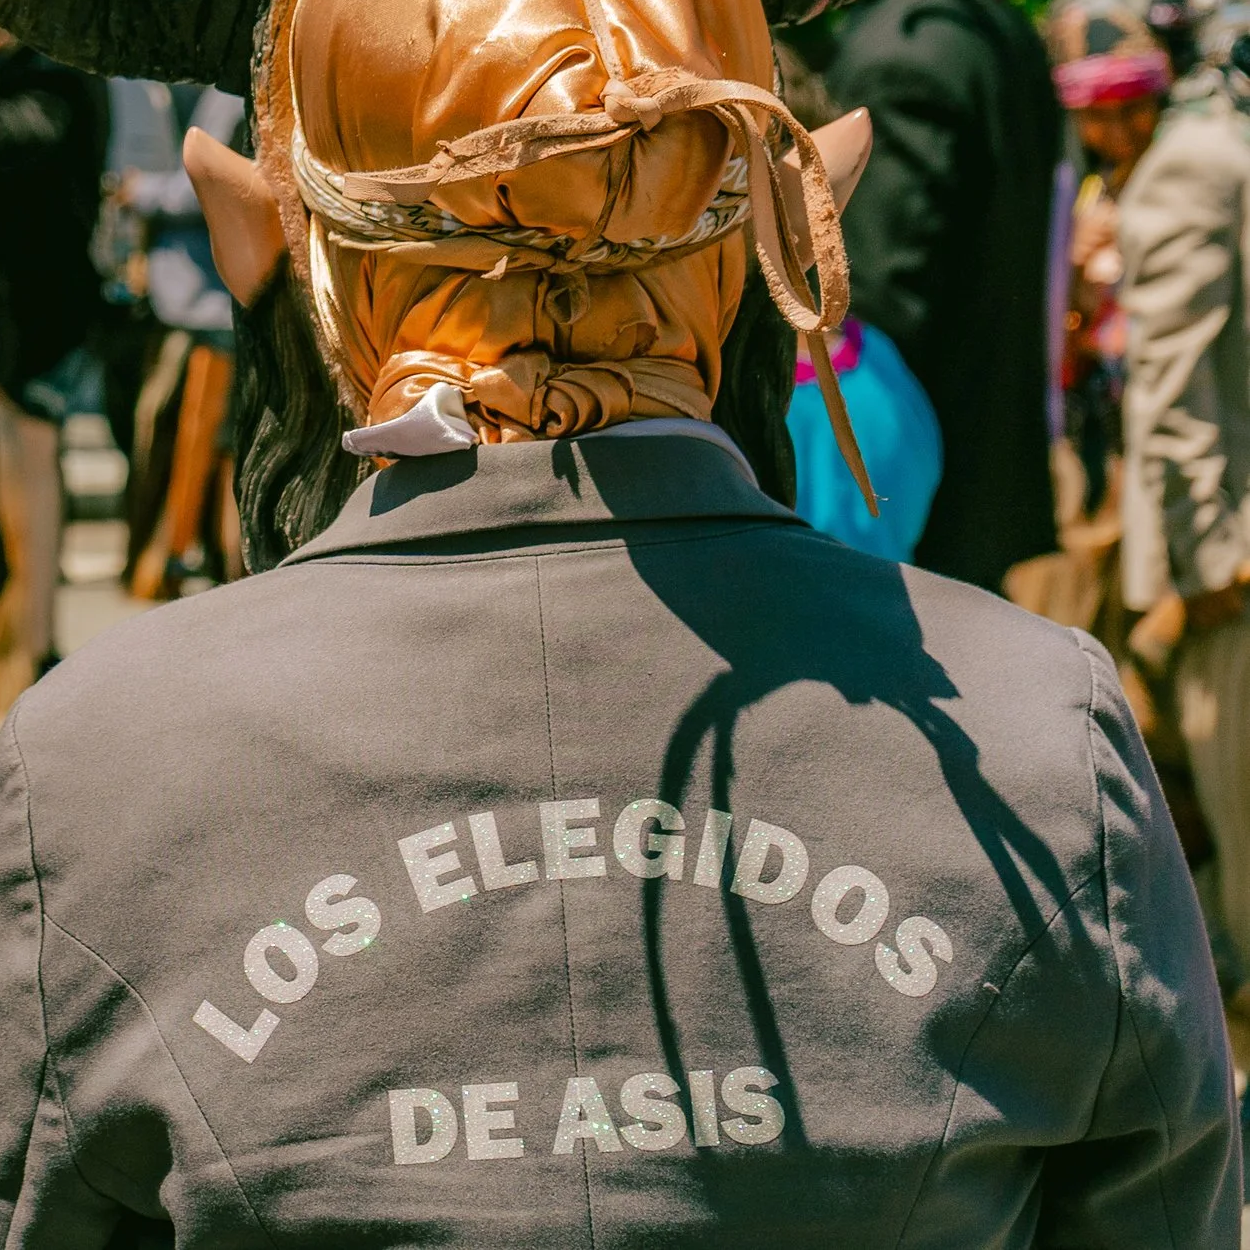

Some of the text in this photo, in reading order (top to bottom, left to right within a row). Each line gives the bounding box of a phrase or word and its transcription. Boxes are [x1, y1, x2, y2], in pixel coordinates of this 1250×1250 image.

[192, 798, 954, 1064] LOS ELEGIDOS
[388, 1066, 786, 1165] DE ASIS
